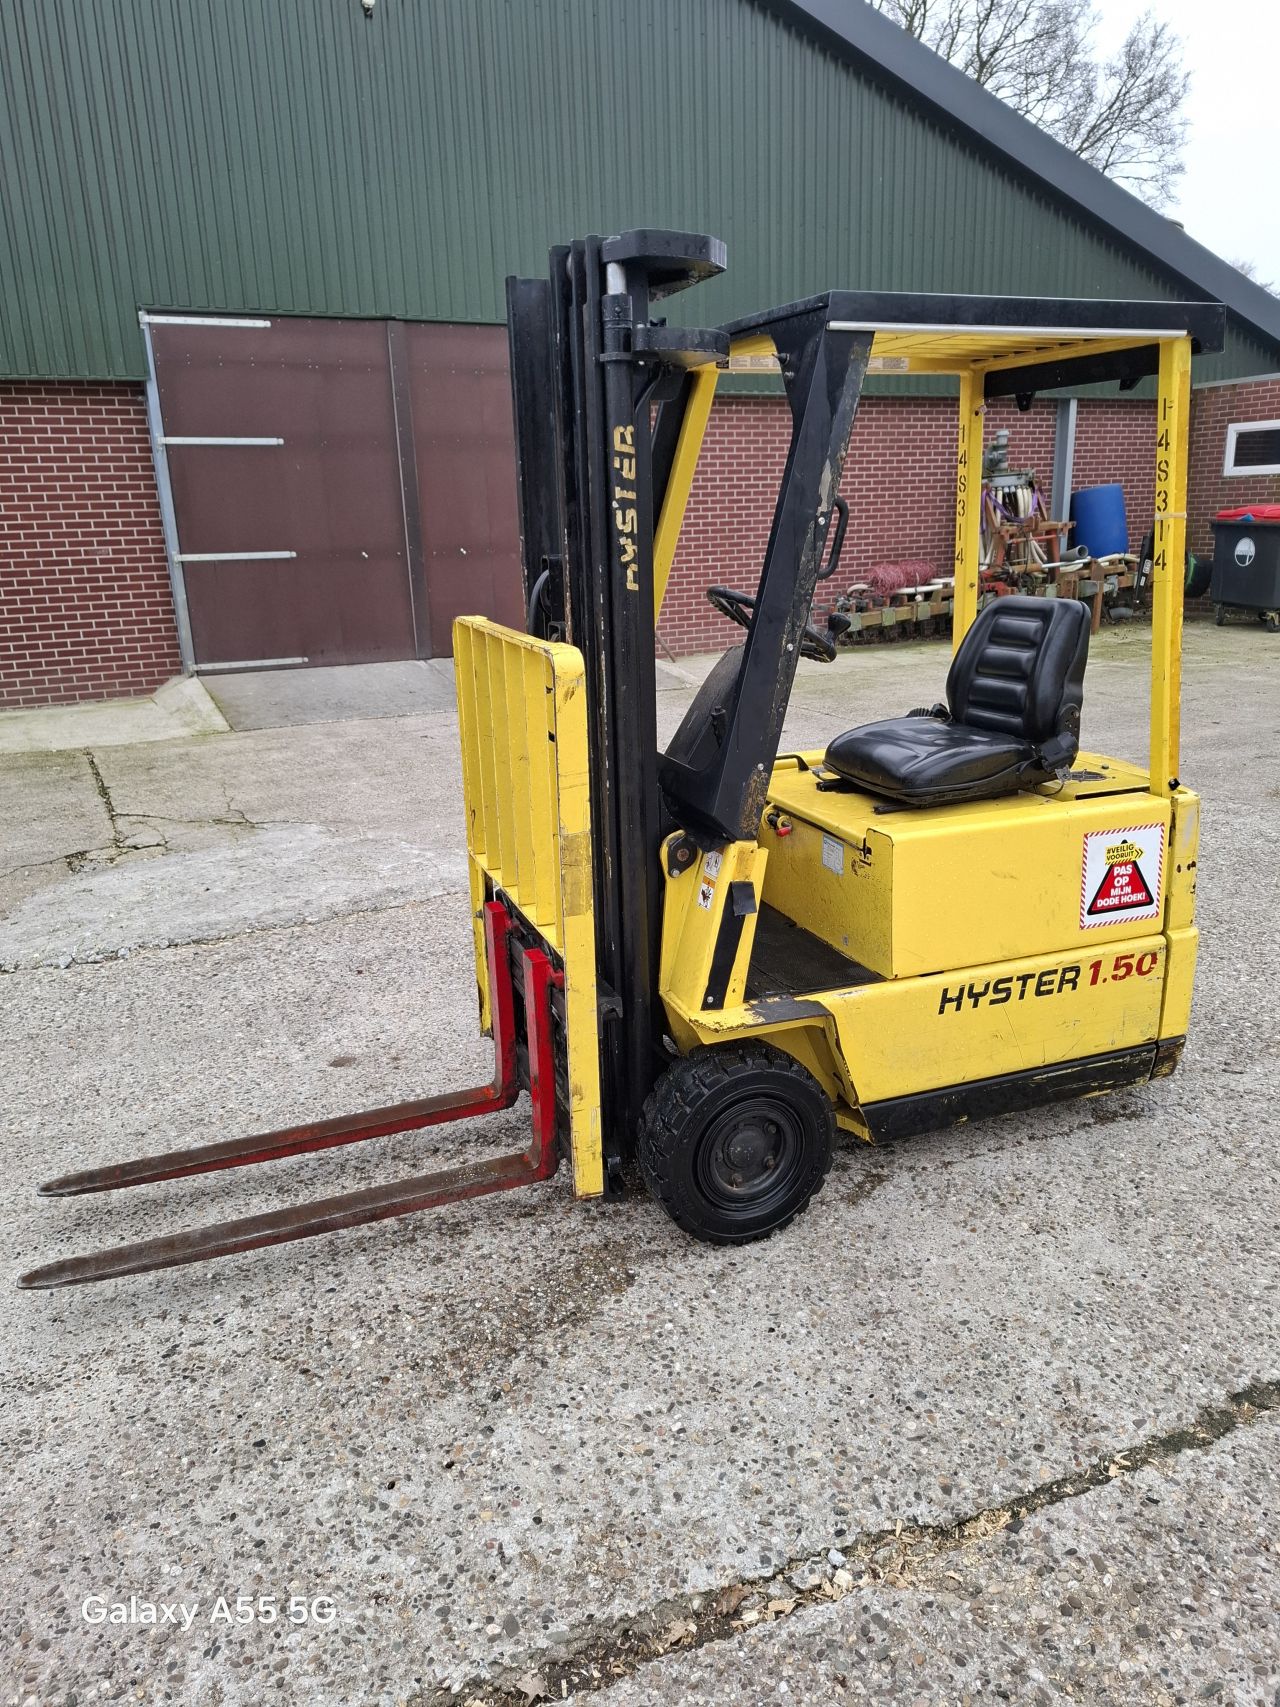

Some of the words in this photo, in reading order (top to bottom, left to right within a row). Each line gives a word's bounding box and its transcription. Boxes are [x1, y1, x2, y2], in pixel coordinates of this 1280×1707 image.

[1106, 844, 1134, 854] #VEILIG
[1106, 851, 1134, 860] VOORUIT
[1114, 865, 1132, 876] PAS
[1114, 876, 1129, 886] OP
[1110, 886, 1131, 896] MIJN
[1097, 896, 1119, 907] DODE
[1121, 892, 1145, 903] HOEK!
[938, 965, 1081, 1015] HYSTER
[1088, 950, 1158, 986] 1.50
